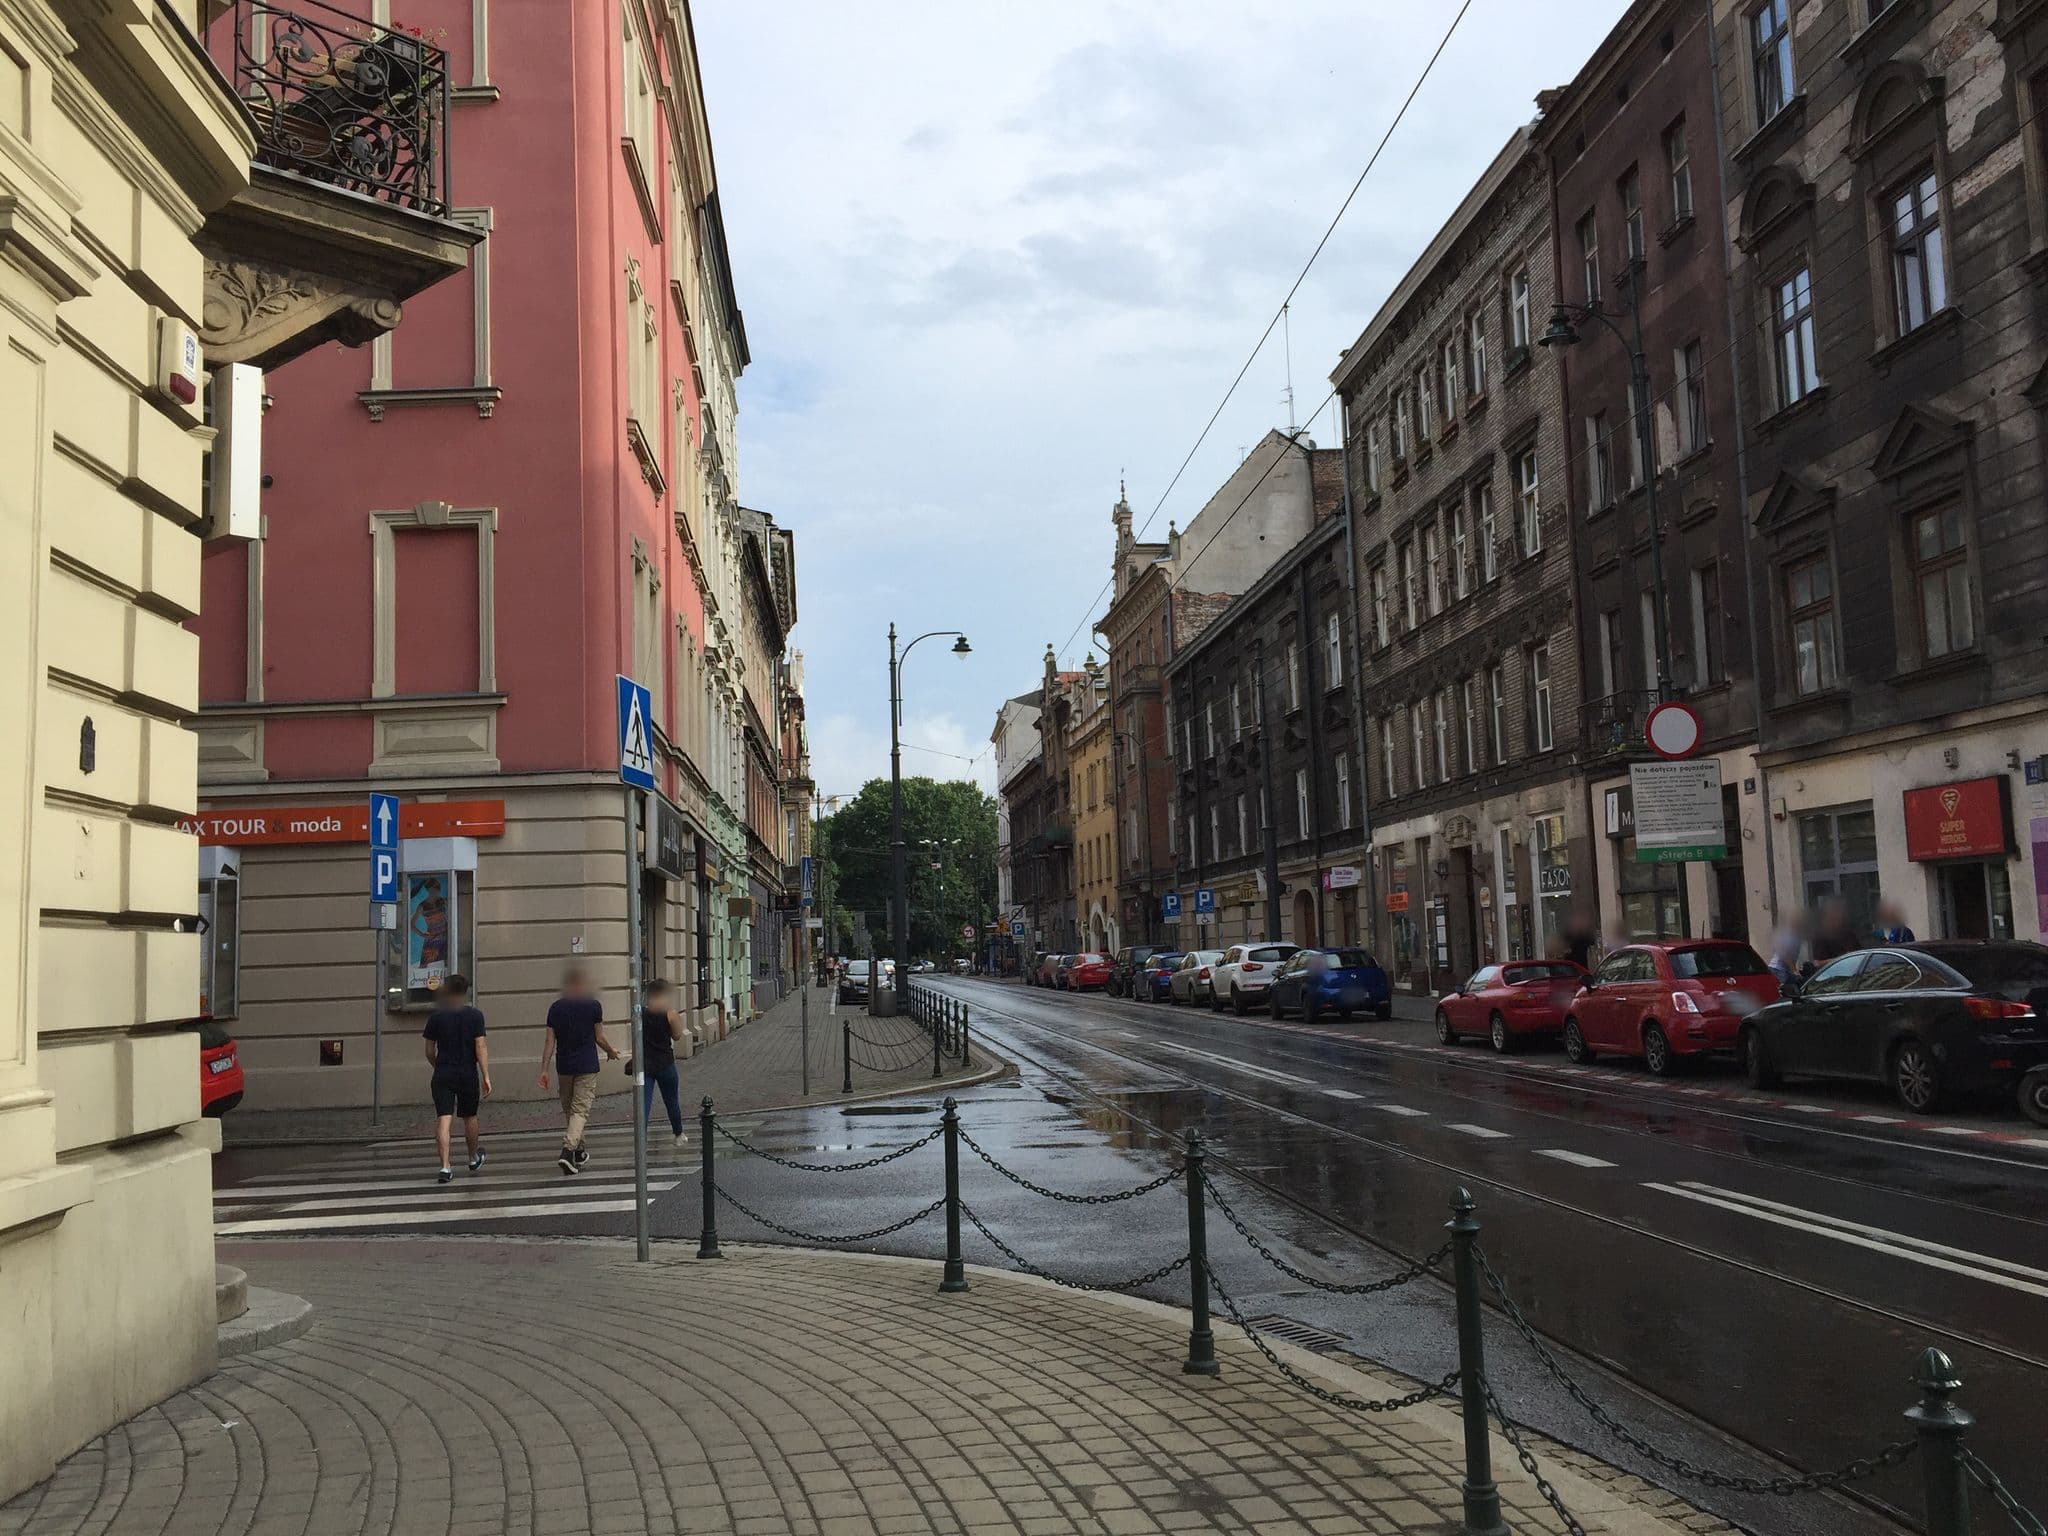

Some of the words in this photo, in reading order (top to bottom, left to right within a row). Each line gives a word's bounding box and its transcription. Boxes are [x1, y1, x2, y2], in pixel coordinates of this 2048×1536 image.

[210, 818, 267, 836] TOUR
[290, 816, 342, 833] moda
[1940, 820, 1965, 834] SUPER
[1940, 833, 1968, 845] HEROES
[377, 855, 393, 896] P
[1541, 868, 1571, 889] FASON
[1166, 895, 1178, 910] P
[1199, 891, 1210, 907] P
[1014, 923, 1022, 935] P
